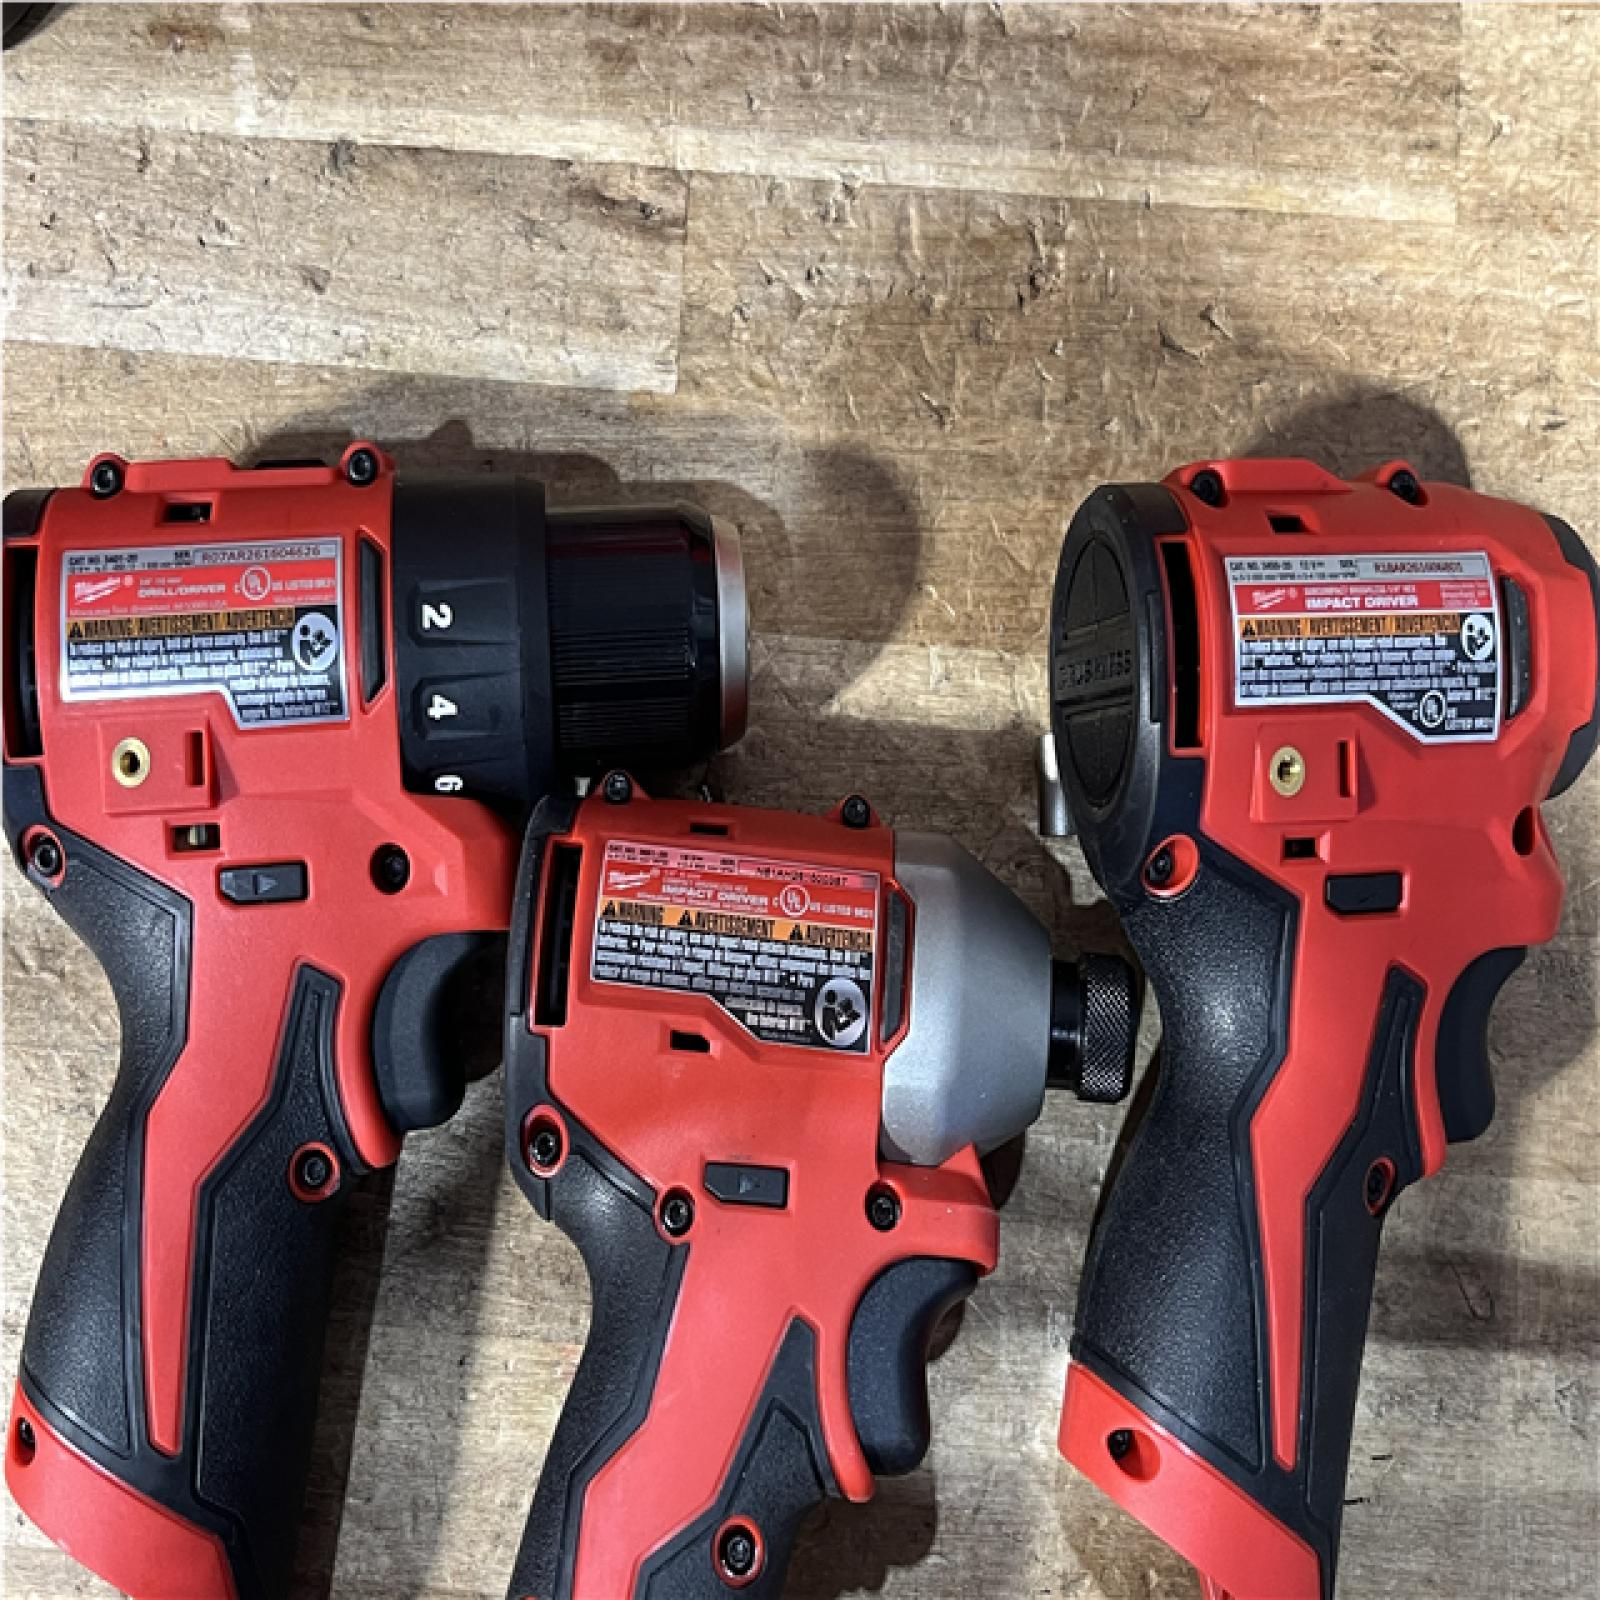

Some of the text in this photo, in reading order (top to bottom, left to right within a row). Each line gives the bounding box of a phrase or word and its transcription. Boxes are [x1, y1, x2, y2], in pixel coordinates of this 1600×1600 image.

[1305, 595, 1418, 610] IMPACT DRIVER
[421, 603, 453, 630] 2
[427, 694, 458, 720] 4
[618, 901, 664, 922] WARNING
